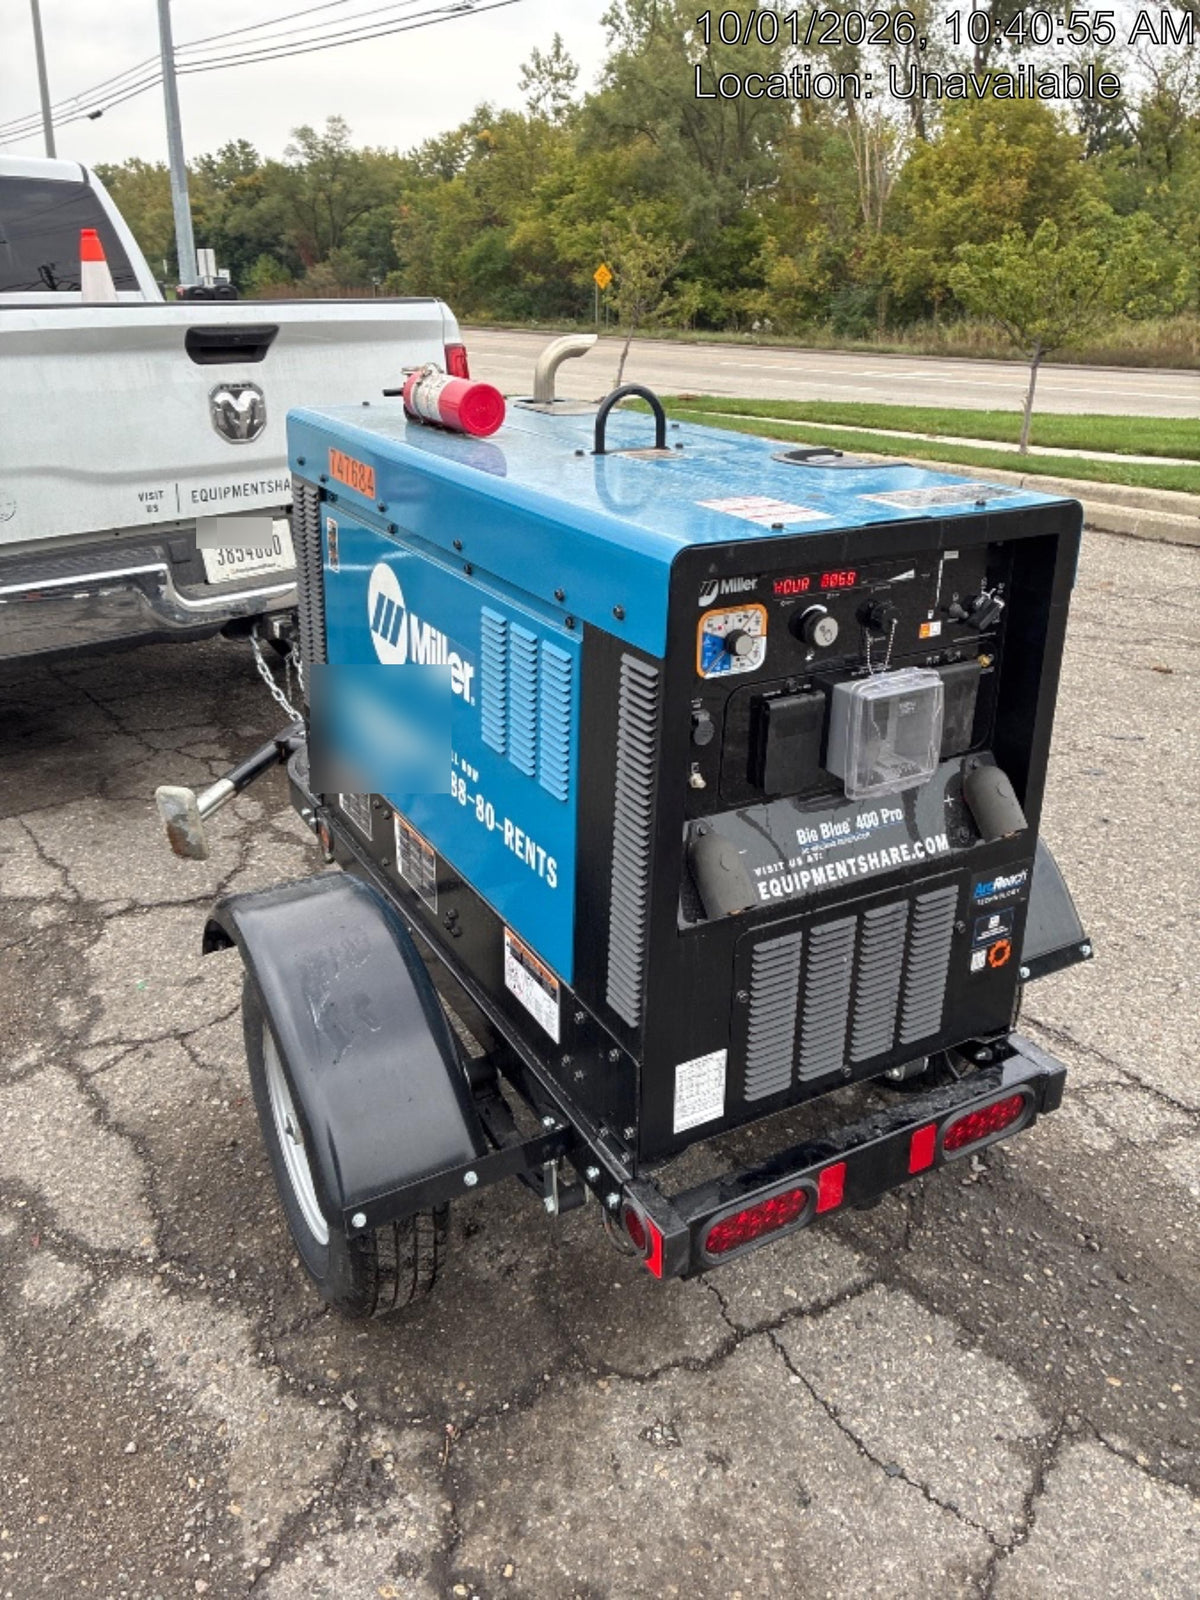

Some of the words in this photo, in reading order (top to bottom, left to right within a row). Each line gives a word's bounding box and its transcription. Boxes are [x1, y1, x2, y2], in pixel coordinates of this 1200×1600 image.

[329, 448, 374, 498] 747684
[138, 490, 164, 501] VISIT
[191, 479, 290, 504] EQUIPMENTSHA
[720, 577, 758, 595] Miller
[773, 576, 811, 596] HOUR
[796, 828, 819, 846] Big
[855, 812, 880, 830] 400
[880, 807, 904, 825] Pro
[753, 861, 785, 877] VISIT
[788, 856, 804, 868] US
[806, 852, 823, 864] AT:
[757, 833, 951, 901] EQUIPMENTSHARE.COM
